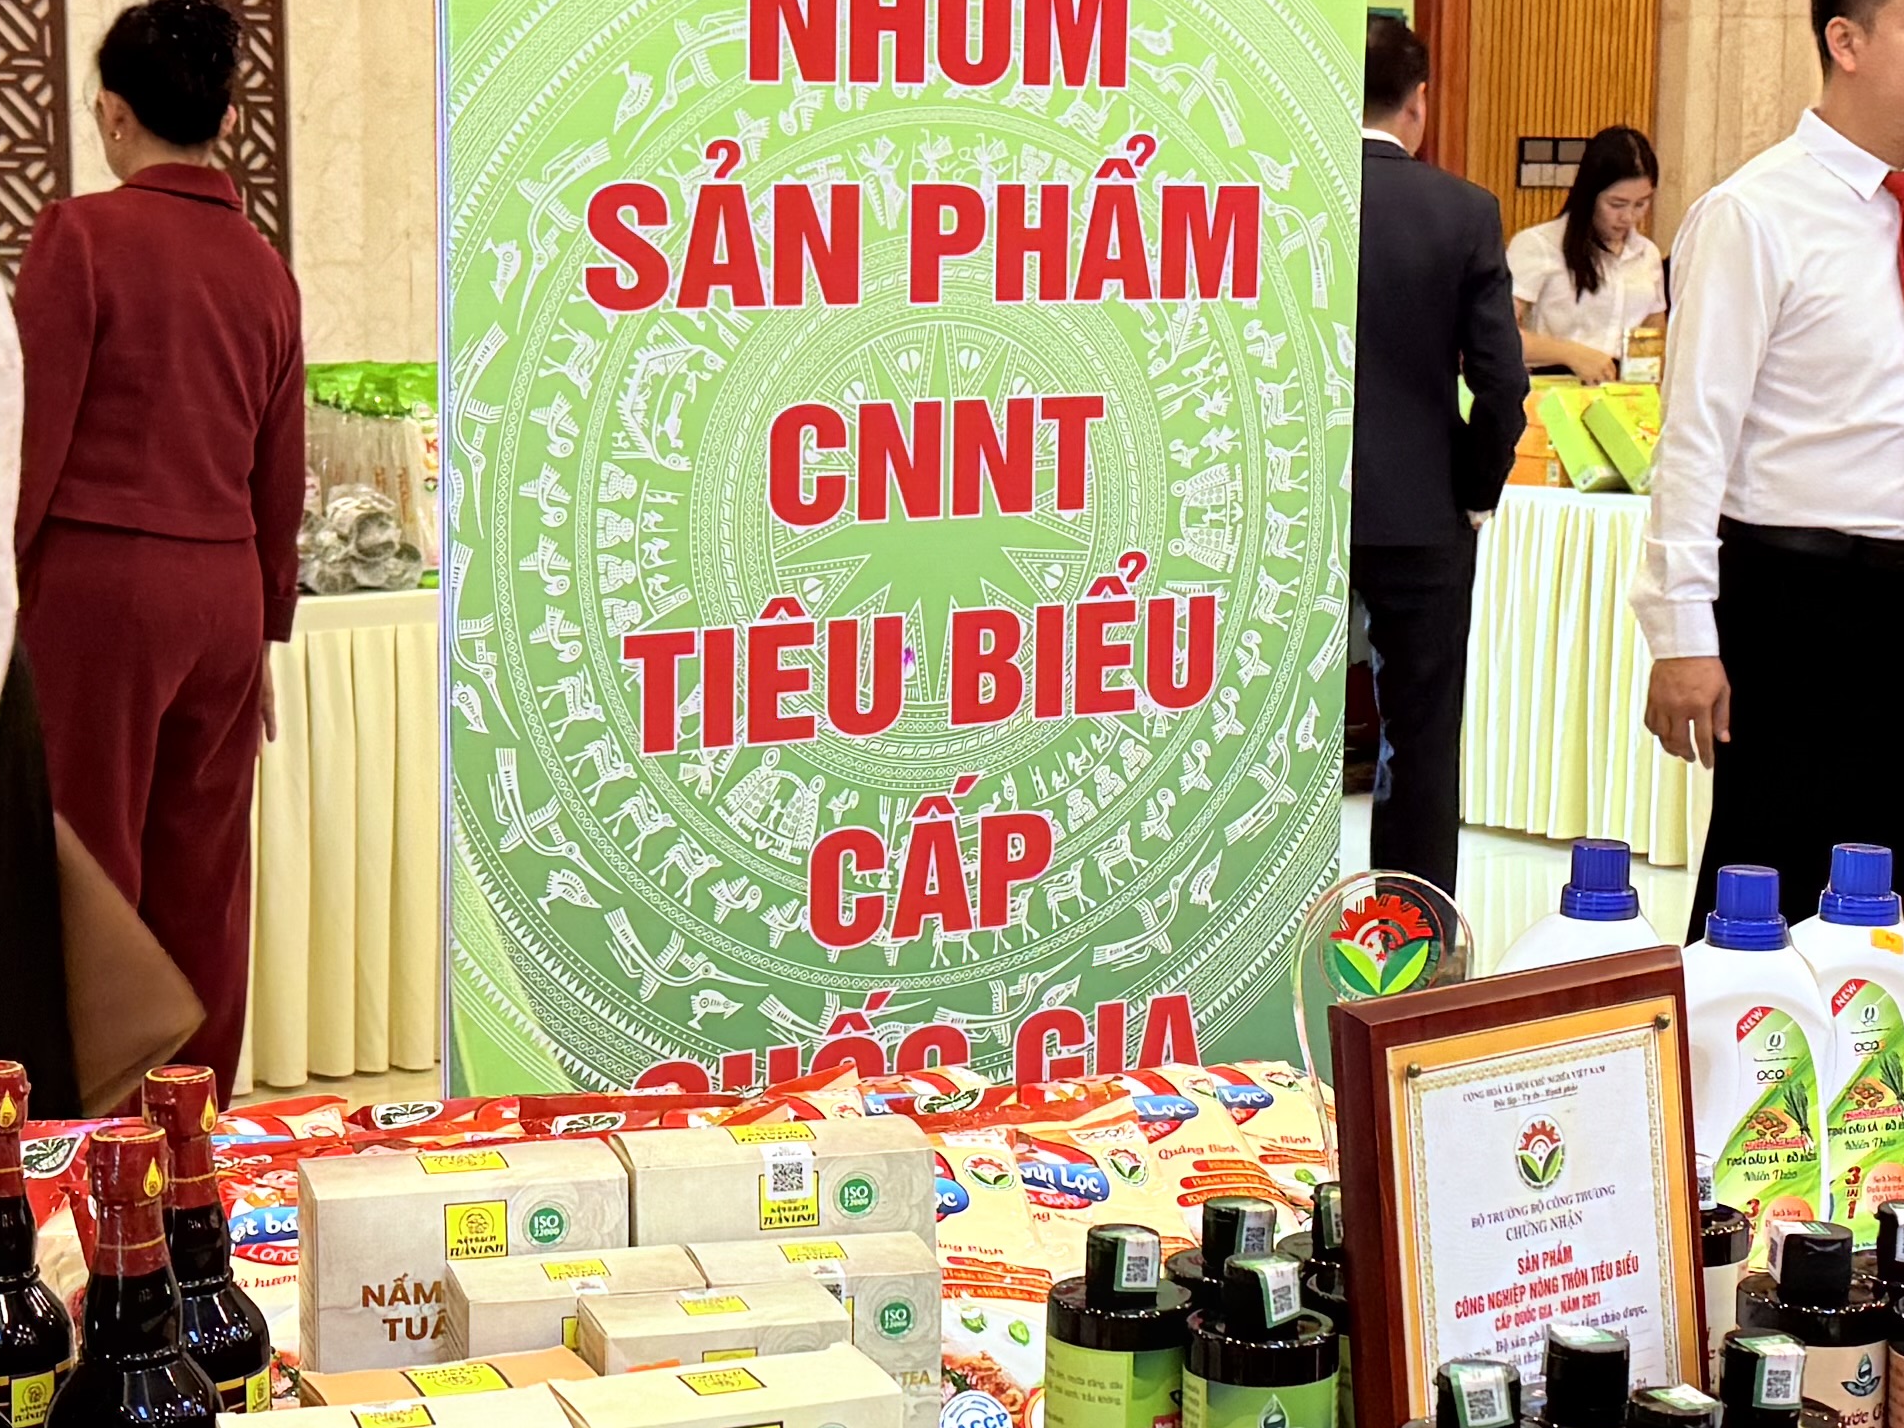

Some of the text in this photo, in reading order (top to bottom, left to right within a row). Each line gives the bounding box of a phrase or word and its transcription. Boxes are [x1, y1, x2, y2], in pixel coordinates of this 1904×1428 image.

[585, 134, 1263, 314] SẢN PHẨM
[767, 394, 1104, 529] CNNT
[622, 551, 1218, 757] TIÊU BIỂU
[807, 773, 1055, 951] CẤP
[1739, 1009, 1764, 1033] NEW
[1835, 980, 1858, 1008] NEW
[1455, 1250, 1640, 1319] CÔNG NGHIỆP NÔNG THÔN TIÊU BIỂU
[1518, 1249, 1539, 1275] SẢN
